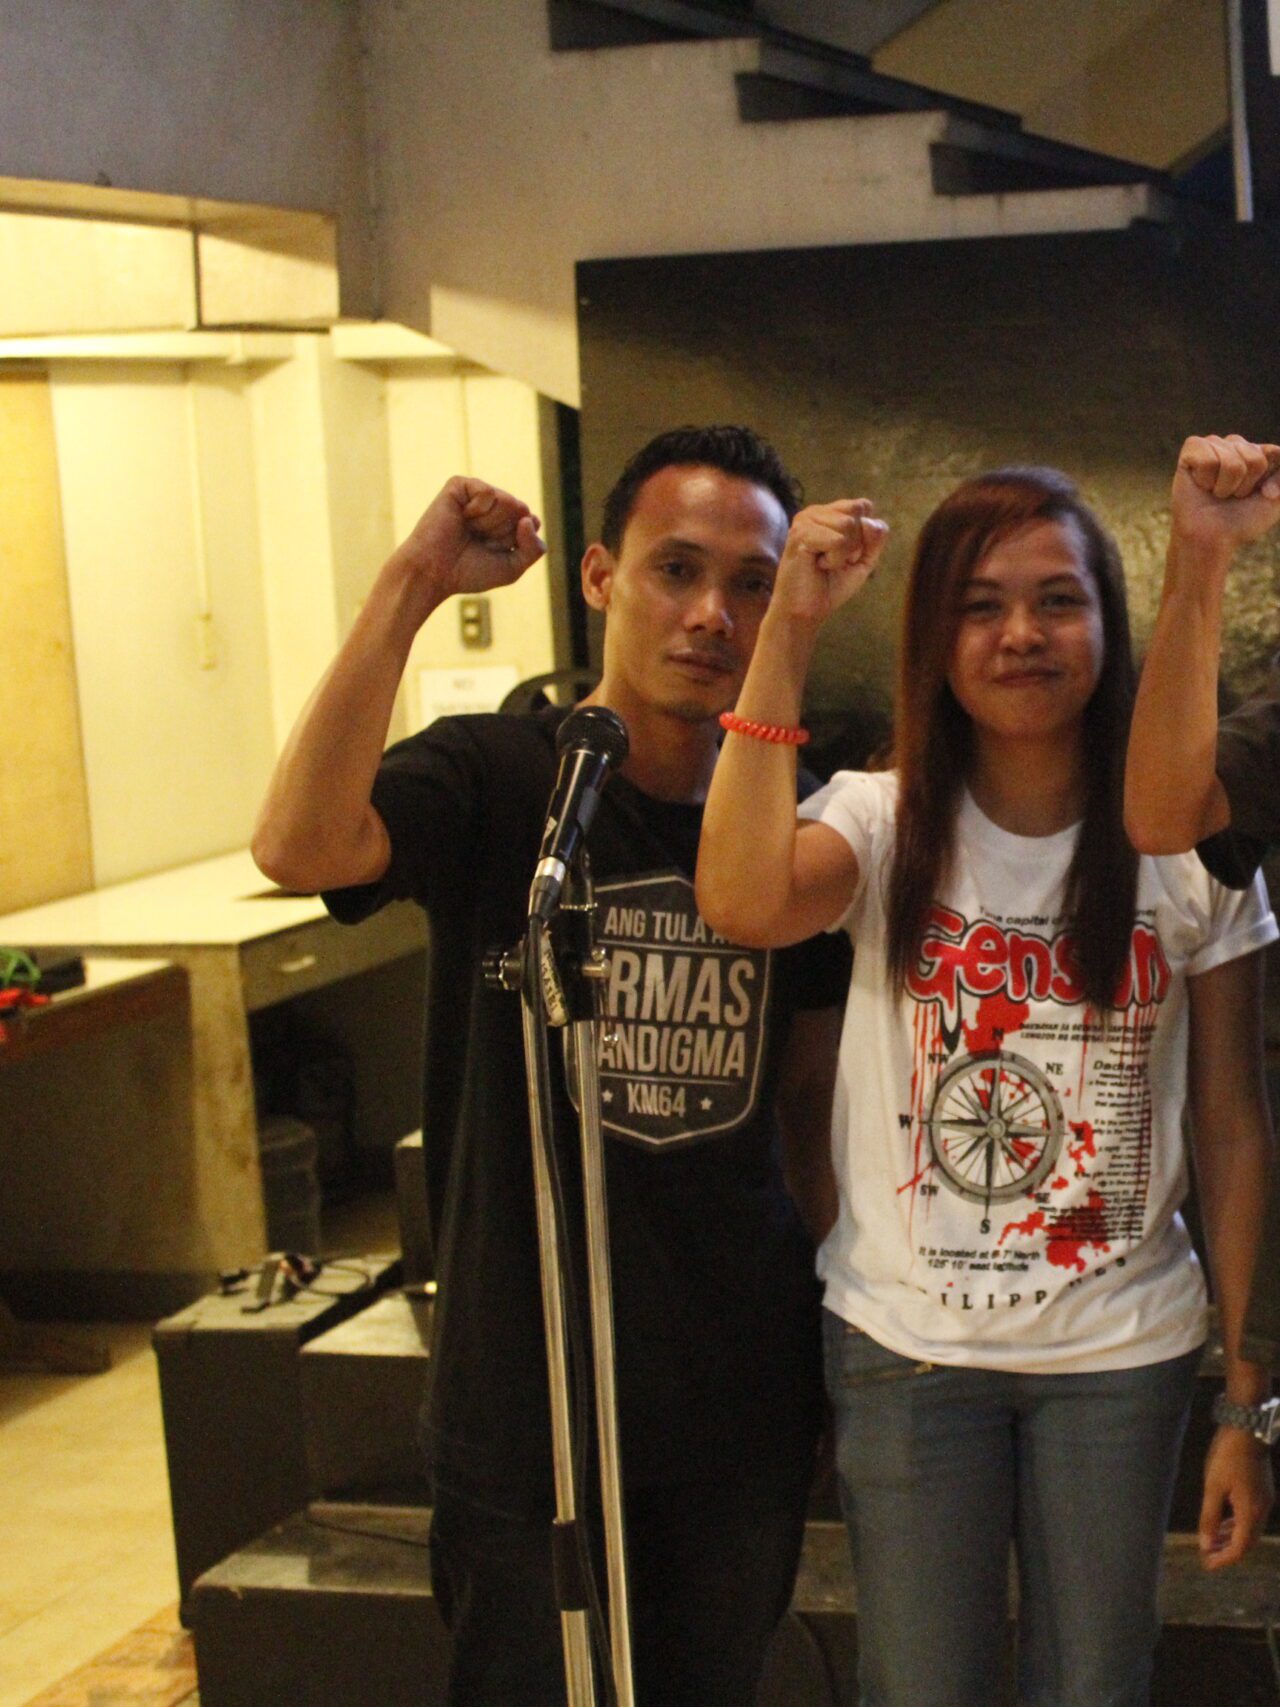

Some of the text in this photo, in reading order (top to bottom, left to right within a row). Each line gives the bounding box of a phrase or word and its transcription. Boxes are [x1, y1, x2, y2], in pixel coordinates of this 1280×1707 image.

[604, 906, 707, 943] ANG TULA
[1006, 915, 1049, 926] capital
[608, 950, 756, 1027] RMAS
[600, 1021, 747, 1078] ANDIGMA
[928, 1053, 949, 1065] NW
[1045, 1062, 1064, 1076] NE
[627, 1082, 687, 1118] KM64
[898, 1114, 914, 1129] W
[920, 1184, 939, 1196] SW
[980, 1218, 991, 1234] S
